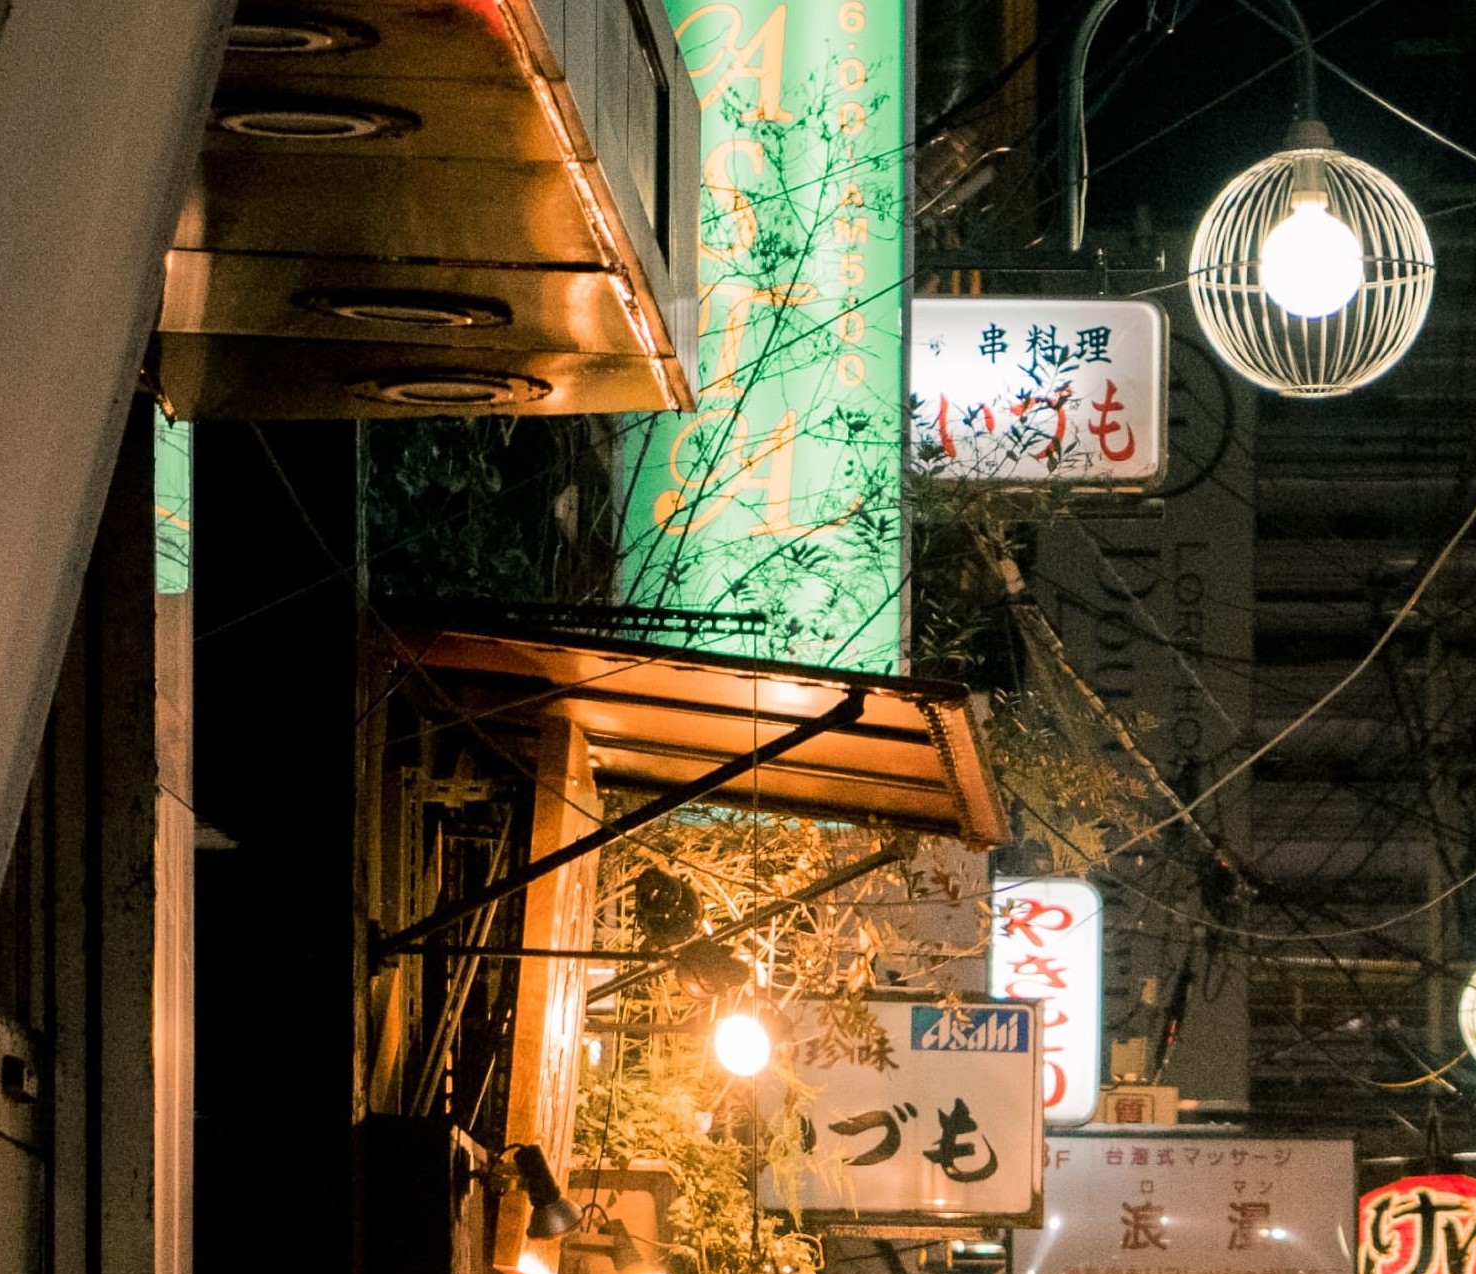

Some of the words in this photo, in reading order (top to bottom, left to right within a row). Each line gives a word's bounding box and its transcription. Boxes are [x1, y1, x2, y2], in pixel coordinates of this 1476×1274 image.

[980, 322, 1113, 365] 串料理
[920, 1008, 1019, 1052] Asahi
